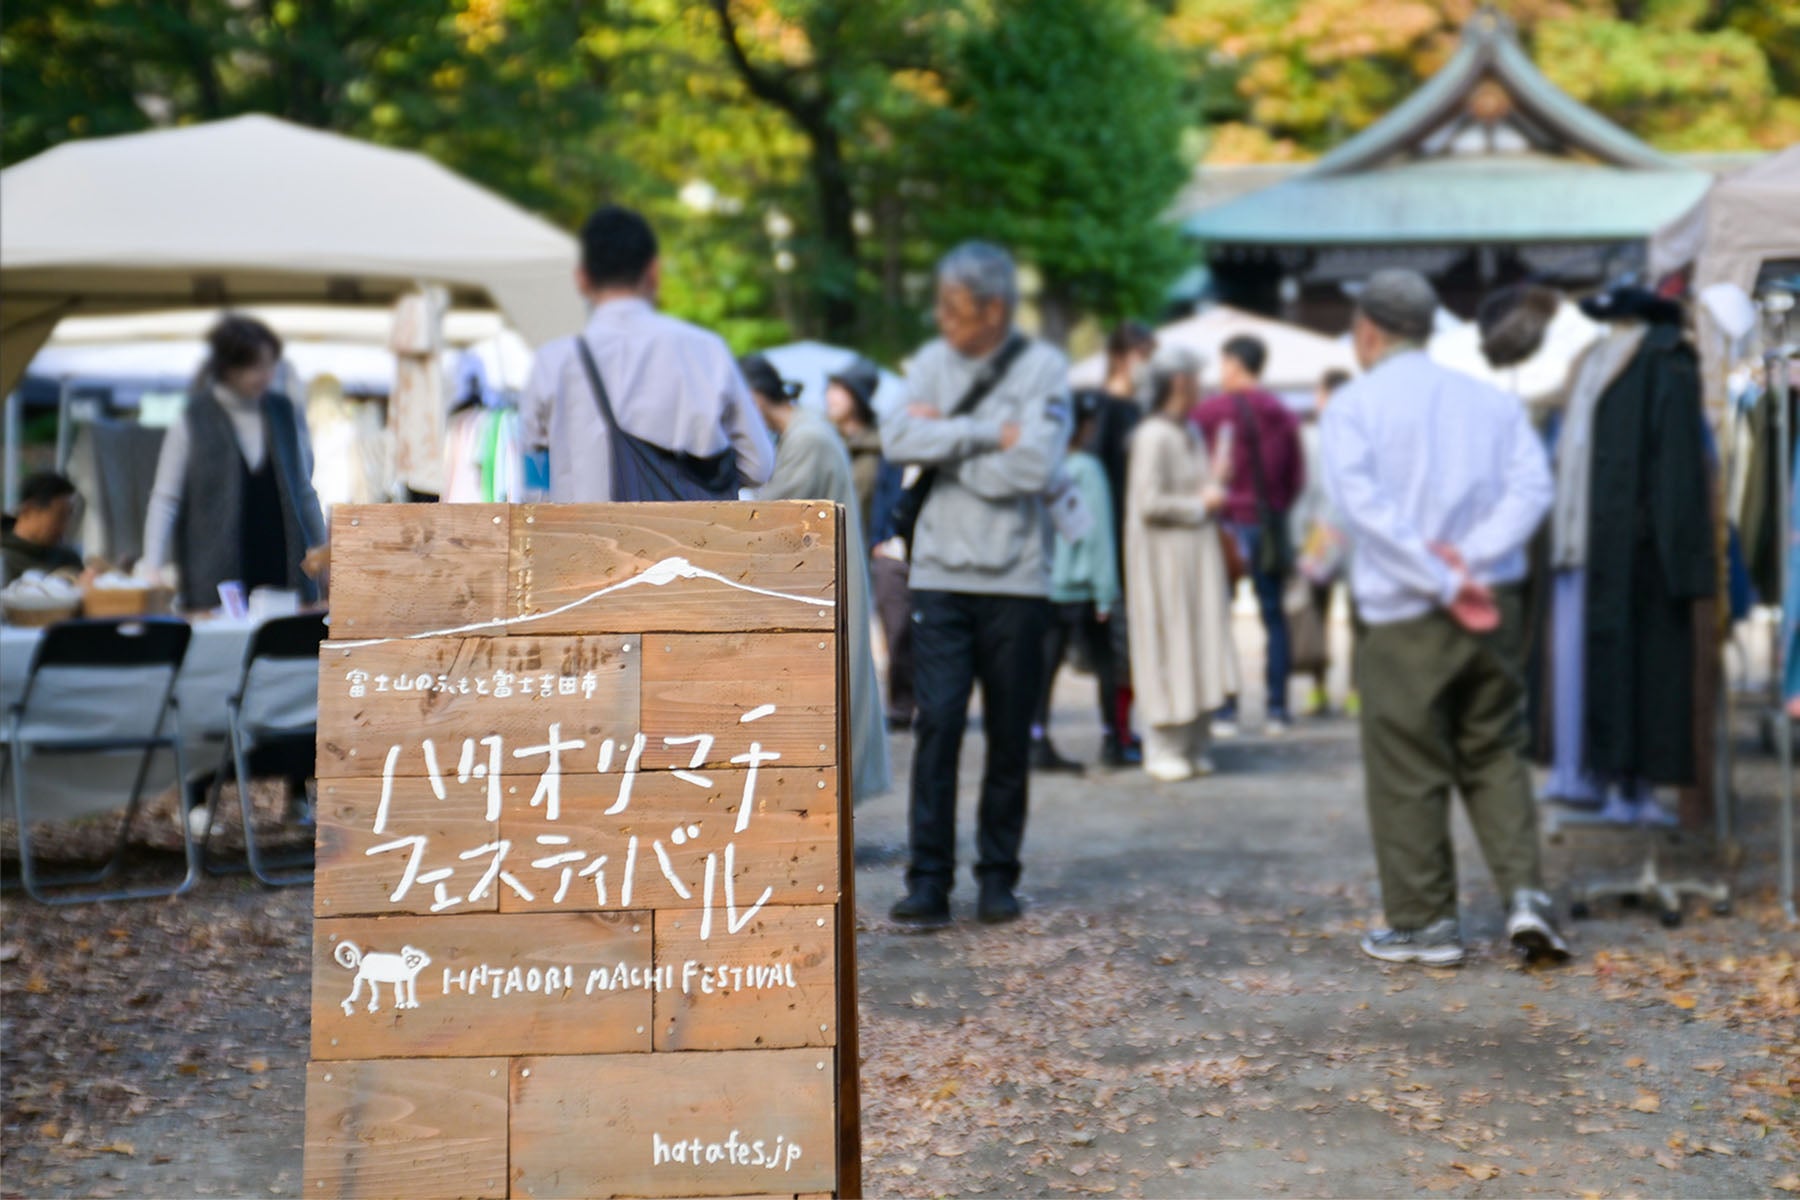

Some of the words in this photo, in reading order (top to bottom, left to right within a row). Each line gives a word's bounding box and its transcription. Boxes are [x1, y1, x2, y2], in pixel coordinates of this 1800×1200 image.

[345, 668, 598, 699] 富士山のふもと富士吉田市
[372, 704, 781, 834] ハタオリマチ
[365, 823, 773, 940] フェスティバル
[442, 963, 573, 999] HATAORI
[585, 961, 673, 995] MACHI
[682, 959, 797, 994] FESTIVAL
[653, 1129, 802, 1172] hatafes.jp
